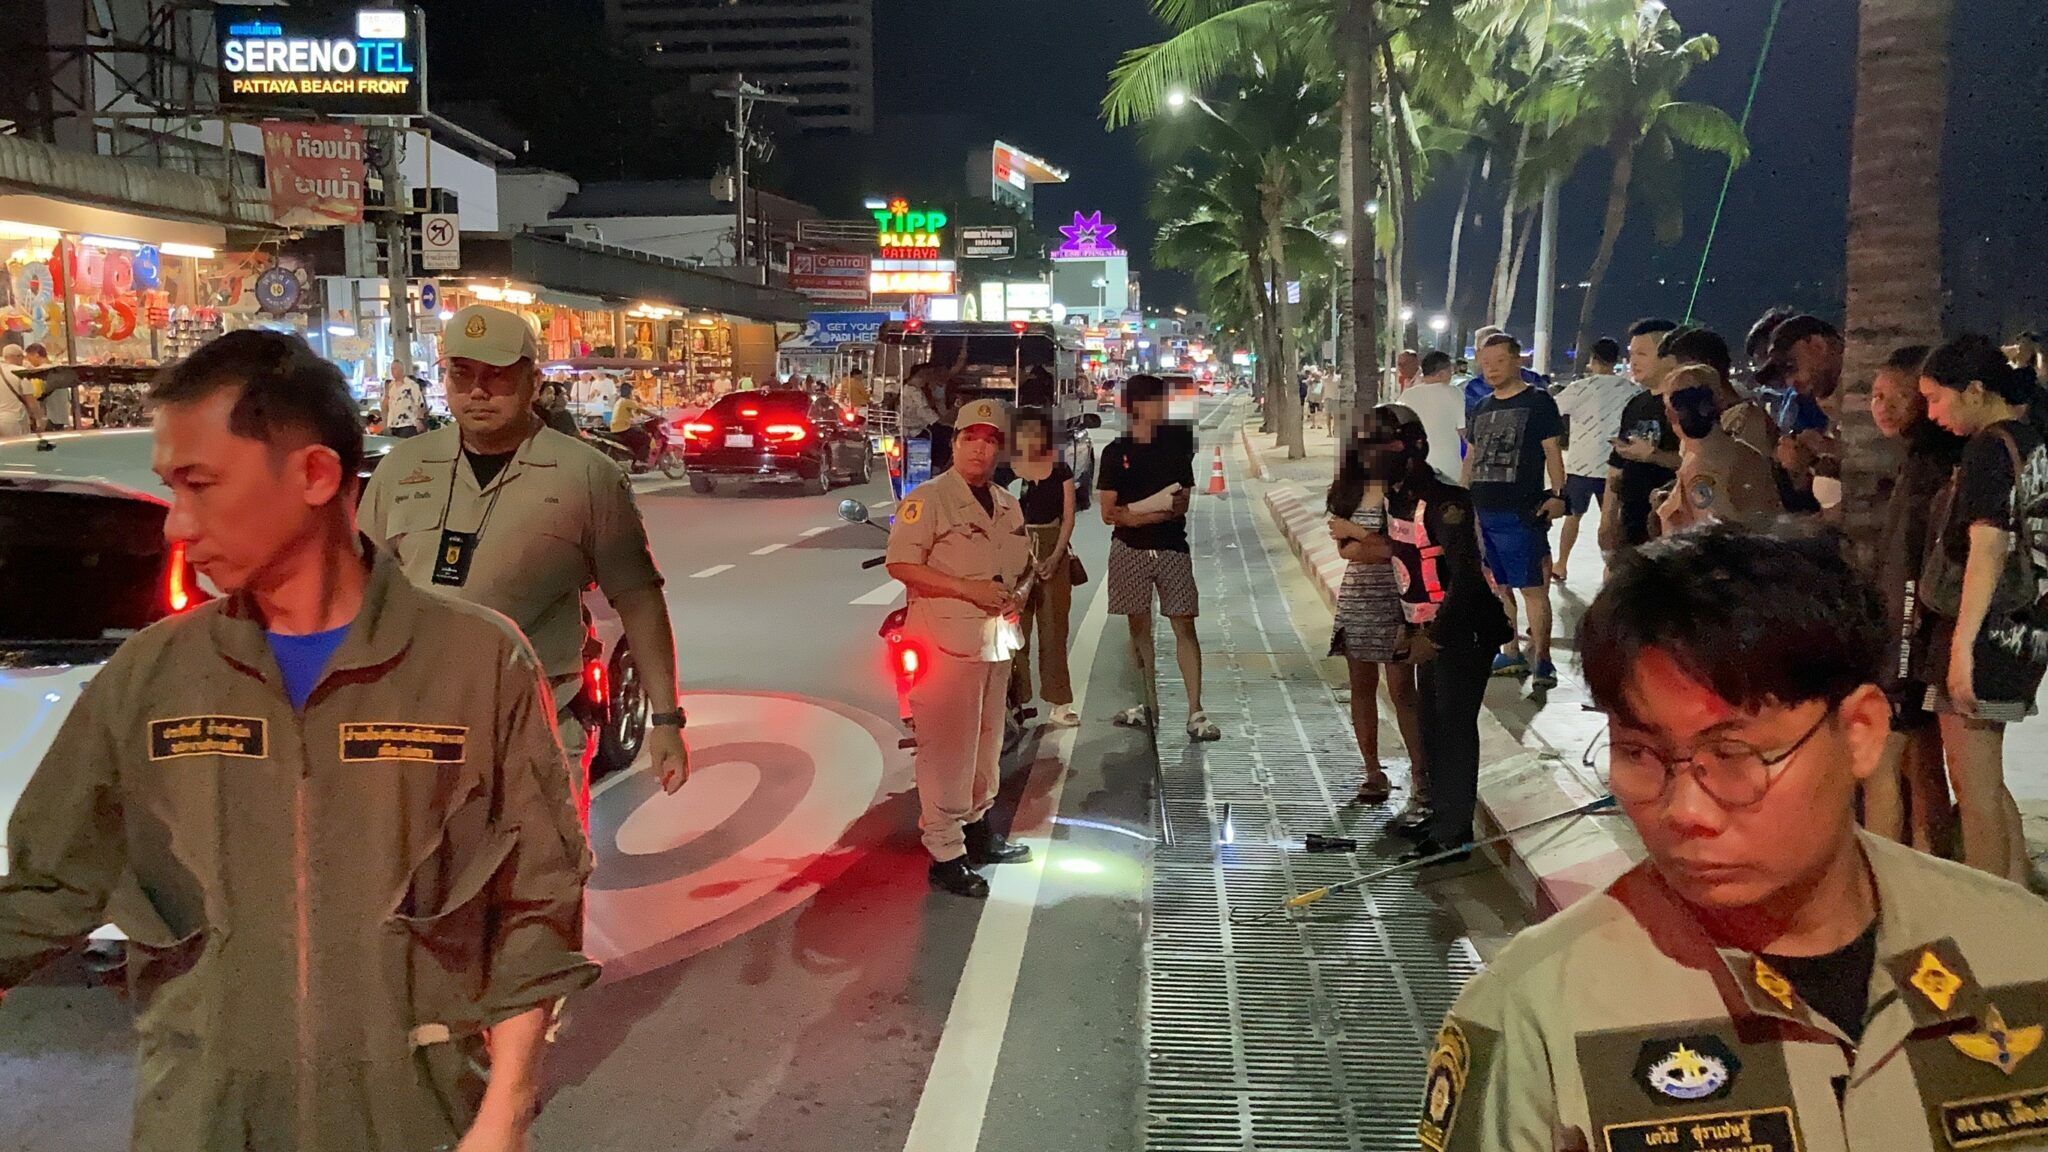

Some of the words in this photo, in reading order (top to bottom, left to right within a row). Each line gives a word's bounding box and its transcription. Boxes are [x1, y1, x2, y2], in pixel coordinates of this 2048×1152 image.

[224, 40, 414, 72] SERENOTEL
[233, 79, 299, 94] PATTAYA
[301, 79, 355, 94] BEACH
[358, 79, 410, 94] FRONT
[297, 128, 361, 161] ห้องน้ำ
[880, 233, 941, 248] PLAZA
[974, 239, 1002, 247] INDIAN
[882, 248, 938, 259] PATTAYA
[817, 255, 865, 268] Central
[827, 322, 847, 331] GET
[851, 322, 880, 331] YOUR
[830, 333, 851, 342] PADI
[1905, 580, 1916, 594] WE
